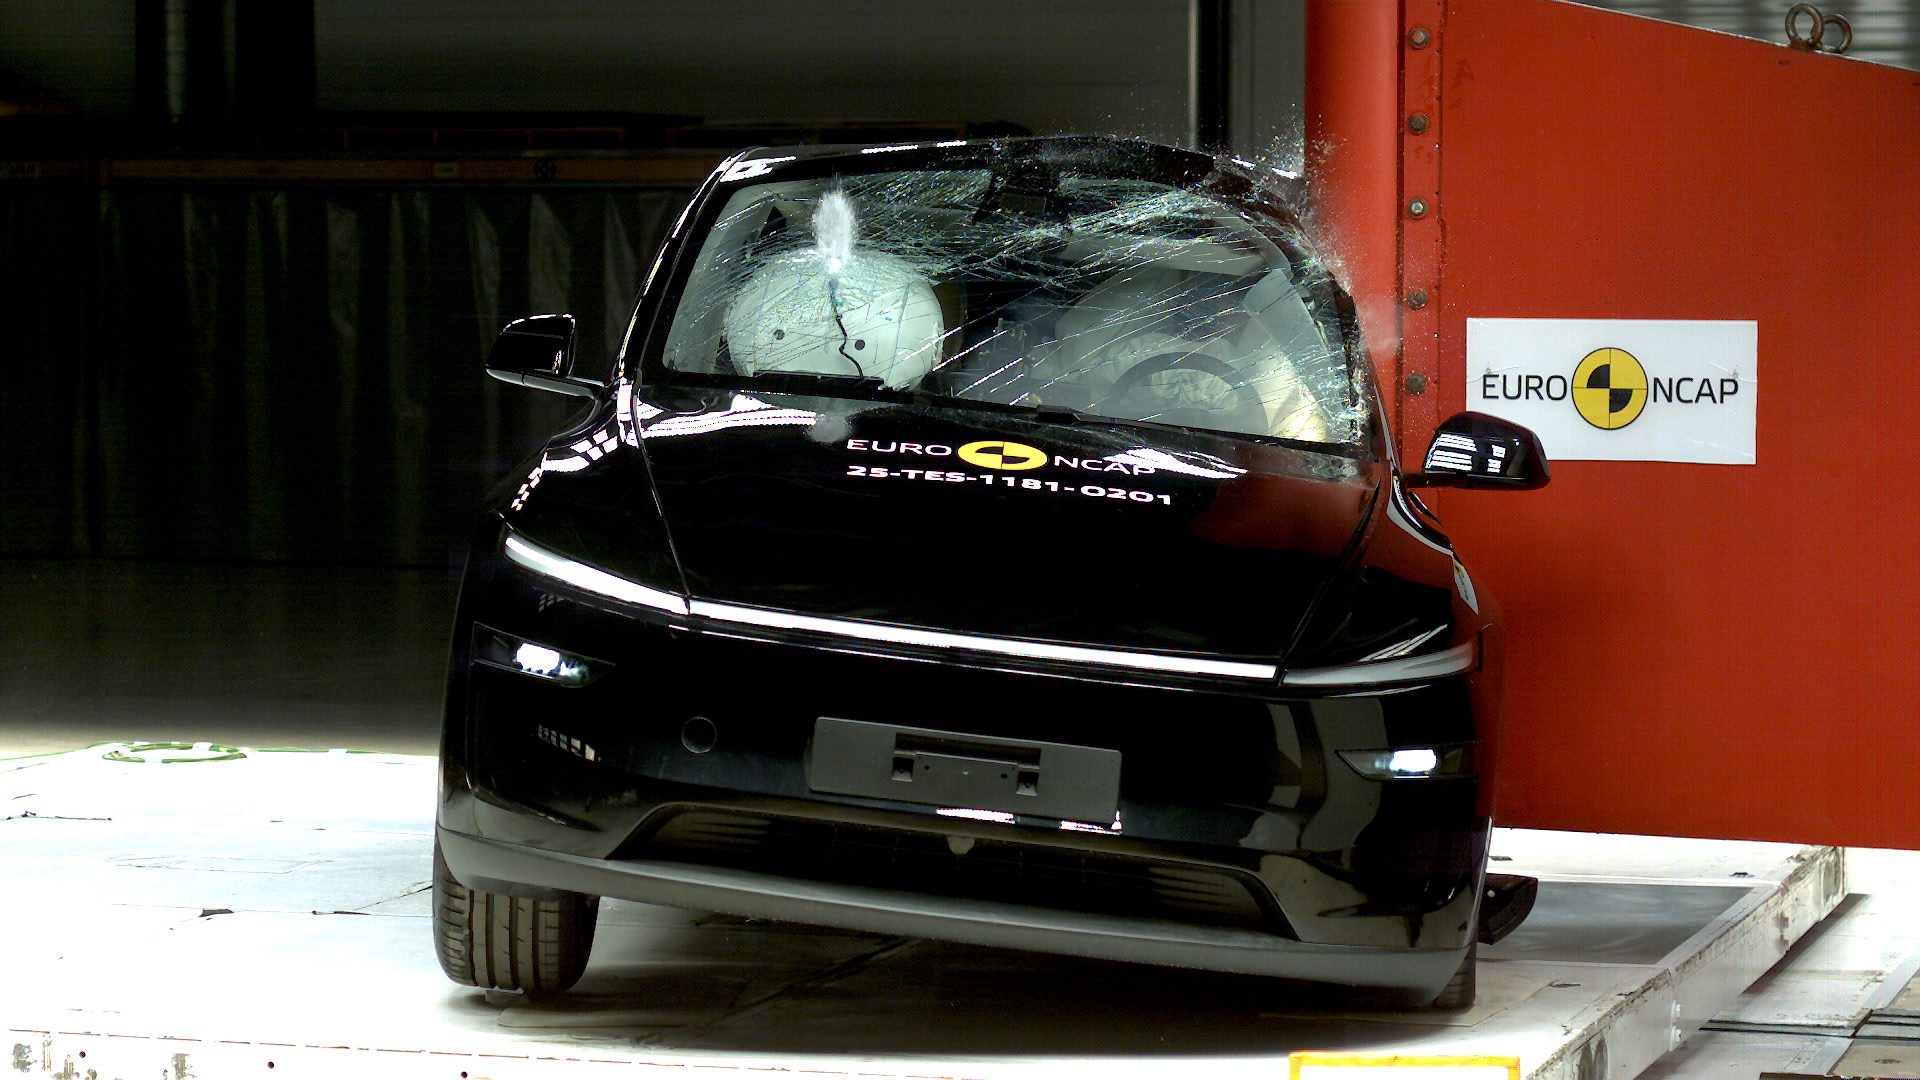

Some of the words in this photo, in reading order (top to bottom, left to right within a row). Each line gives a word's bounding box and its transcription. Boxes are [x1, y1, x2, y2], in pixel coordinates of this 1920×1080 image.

[1482, 374, 1568, 400] EURO
[1653, 377, 1739, 404] NCAP
[846, 439, 952, 456] EURO
[1054, 455, 1156, 476] NCAP
[846, 465, 1171, 506] 25-TES-1181-0201
